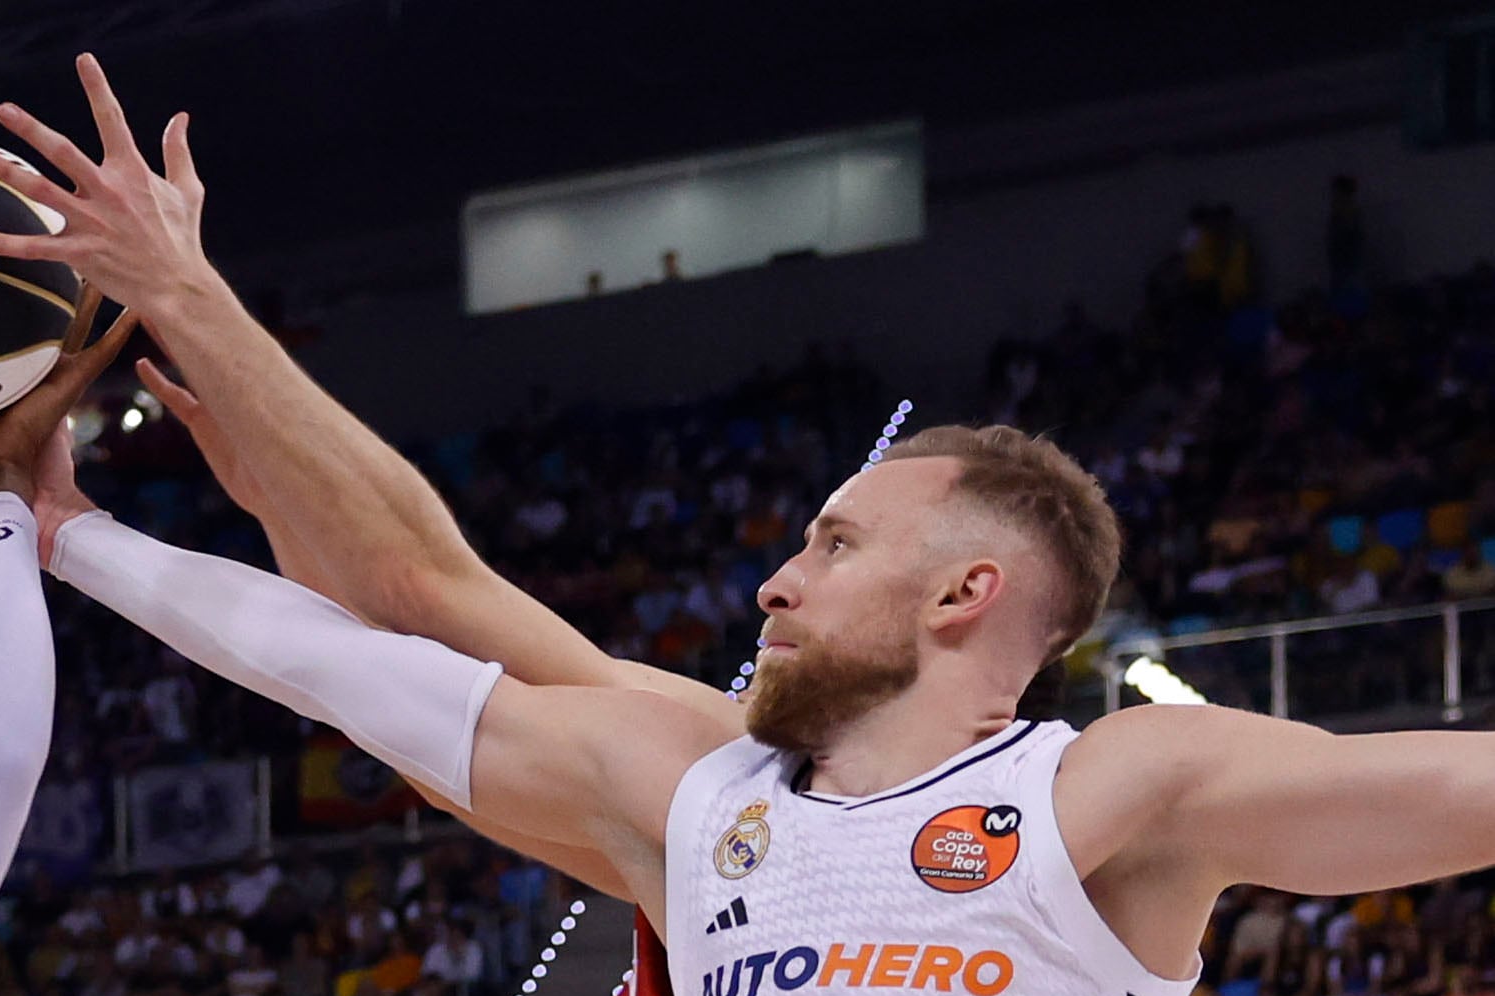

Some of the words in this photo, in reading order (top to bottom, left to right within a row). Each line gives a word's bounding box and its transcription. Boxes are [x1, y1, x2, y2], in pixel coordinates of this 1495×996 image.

[946, 831, 974, 842] acb
[932, 838, 984, 856] Copa
[952, 856, 987, 872] Rey
